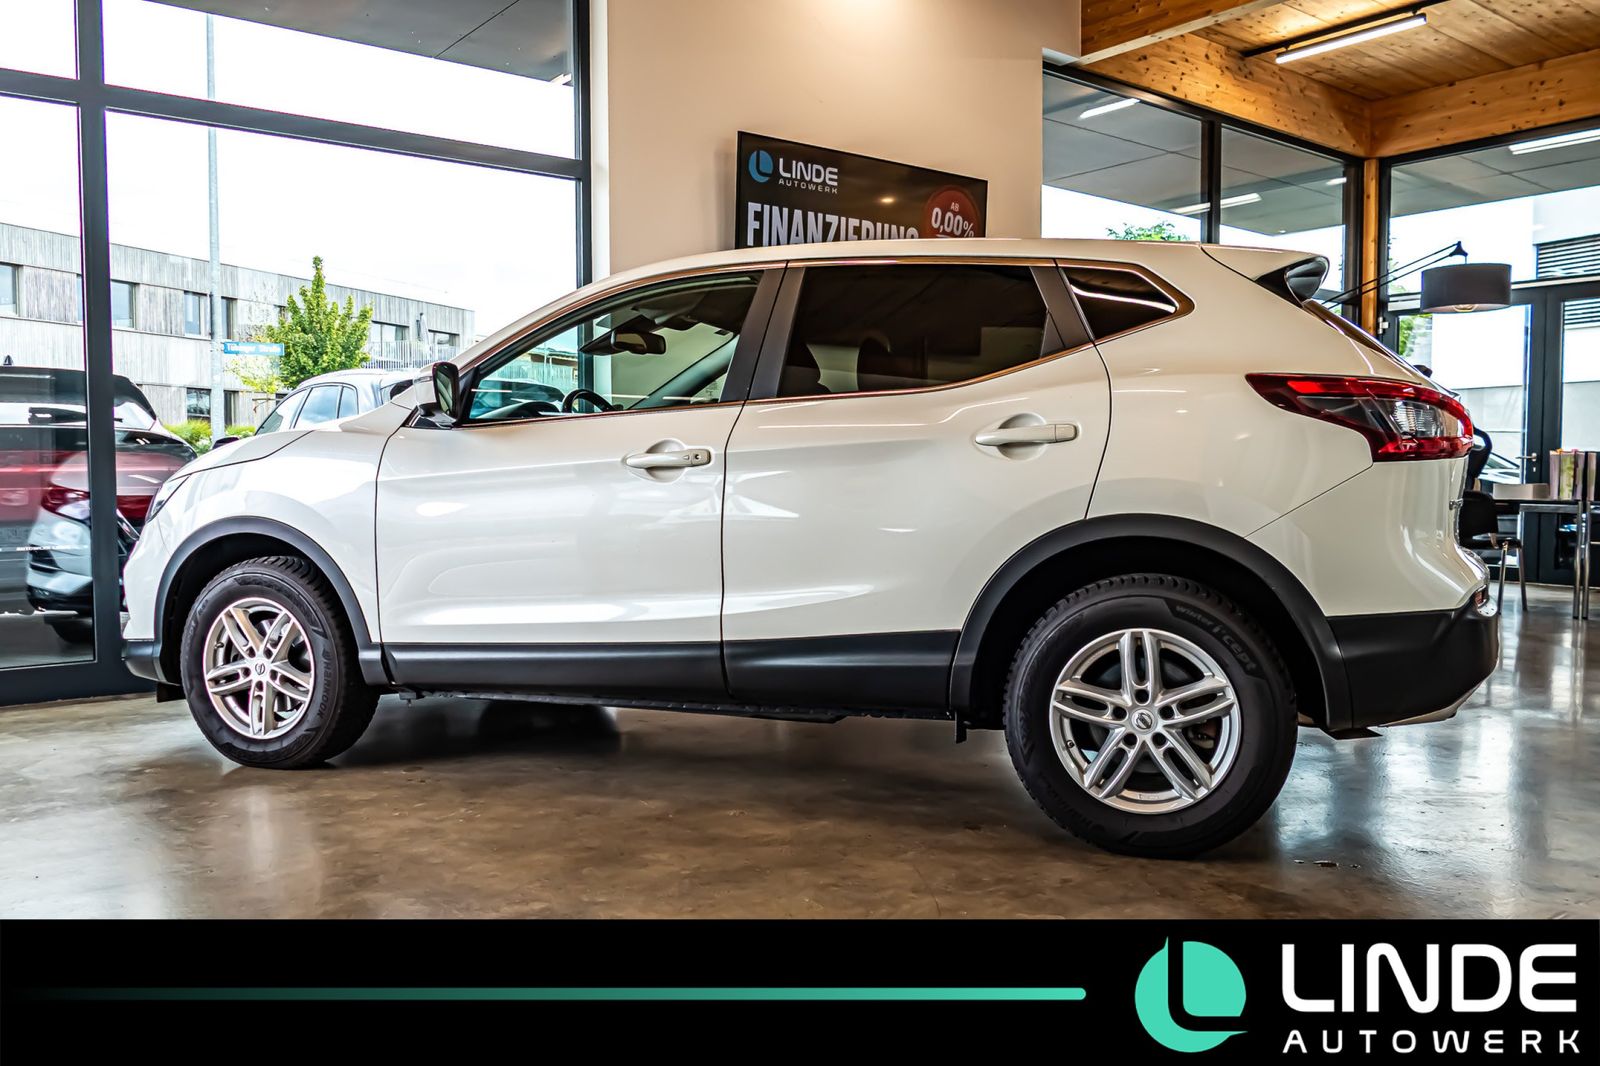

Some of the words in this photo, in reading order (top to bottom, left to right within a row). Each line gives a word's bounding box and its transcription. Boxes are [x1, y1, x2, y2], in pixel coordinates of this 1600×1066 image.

[779, 158, 838, 186] LINDE
[778, 178, 838, 194] AUTOWERK
[950, 202, 960, 212] AB
